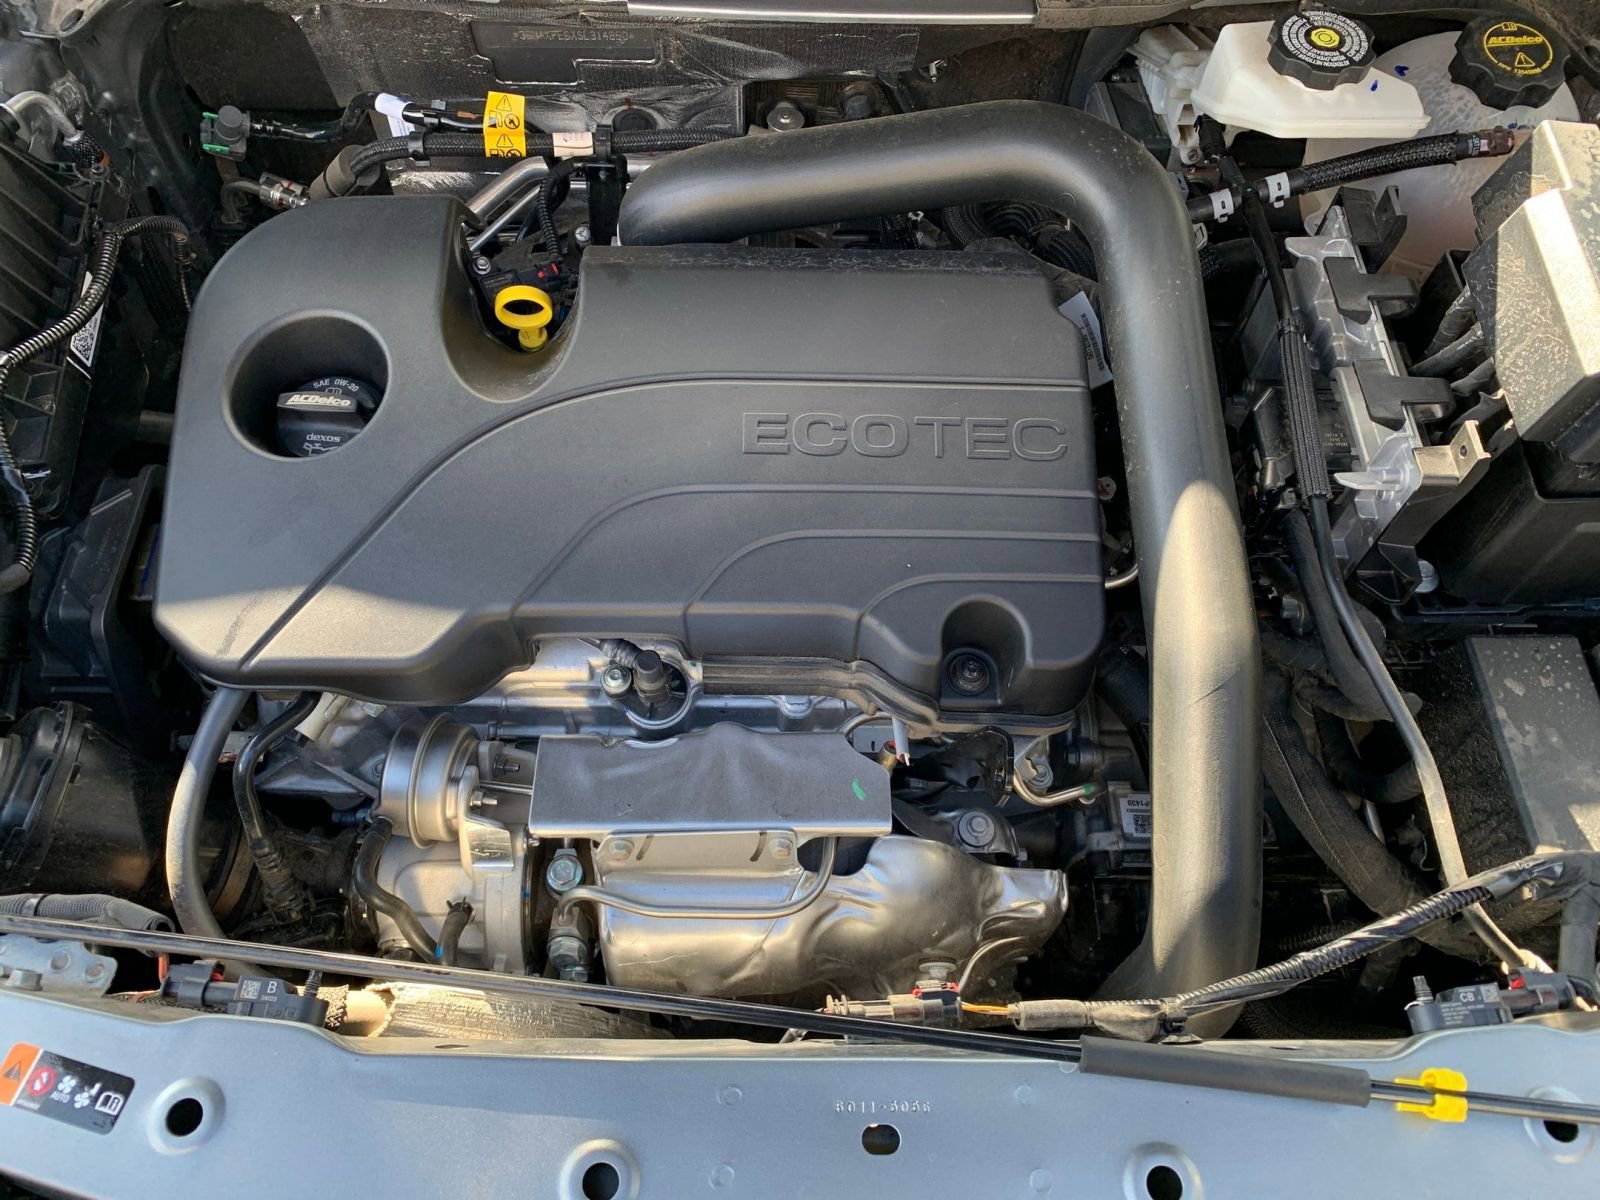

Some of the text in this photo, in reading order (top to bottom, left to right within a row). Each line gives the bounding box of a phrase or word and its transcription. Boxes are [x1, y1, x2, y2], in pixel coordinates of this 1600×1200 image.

[1487, 35, 1543, 45] ACDelco
[313, 379, 330, 389] SAE
[285, 394, 351, 406] ACDelco
[306, 432, 341, 443] dexos
[742, 412, 1068, 462] ECOTEC
[266, 980, 277, 994] B
[49, 1091, 70, 1104] AUTO
